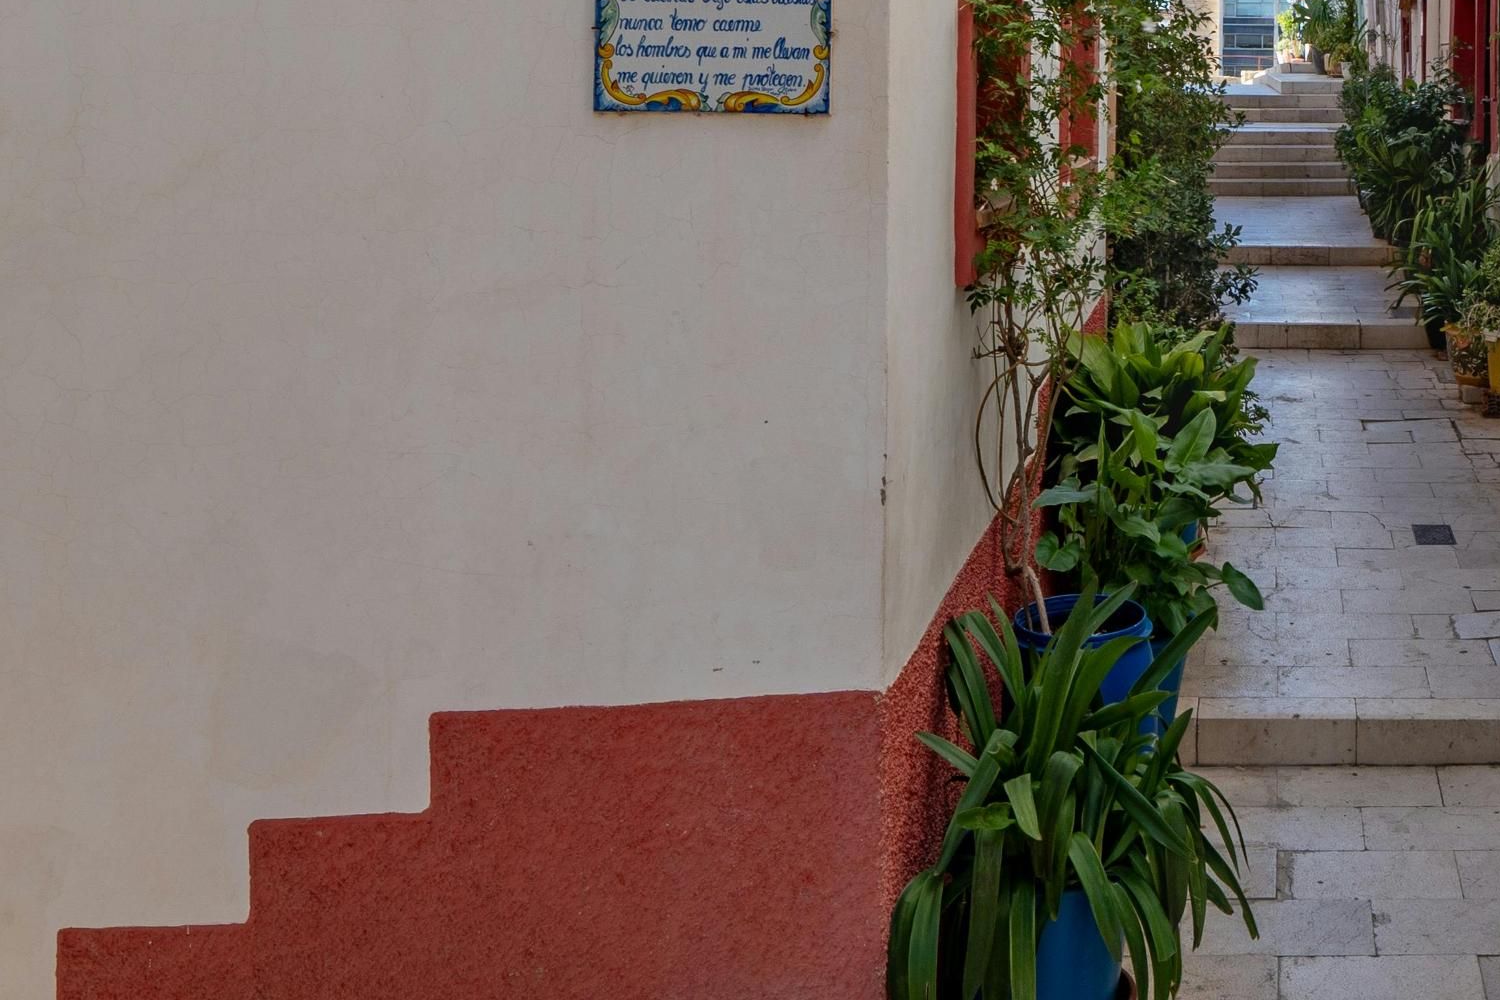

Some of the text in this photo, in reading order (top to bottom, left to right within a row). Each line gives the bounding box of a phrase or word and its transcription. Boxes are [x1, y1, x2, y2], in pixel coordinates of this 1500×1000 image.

[619, 8, 762, 32] nunca temo caerme
[615, 34, 633, 57] los
[636, 34, 691, 58] hombres
[696, 46, 718, 66] que
[720, 46, 729, 58] a
[751, 46, 772, 59] me
[773, 36, 810, 60] llevan
[617, 71, 638, 83] me
[641, 64, 694, 91] quieren
[698, 72, 709, 93] y
[713, 72, 736, 85] me
